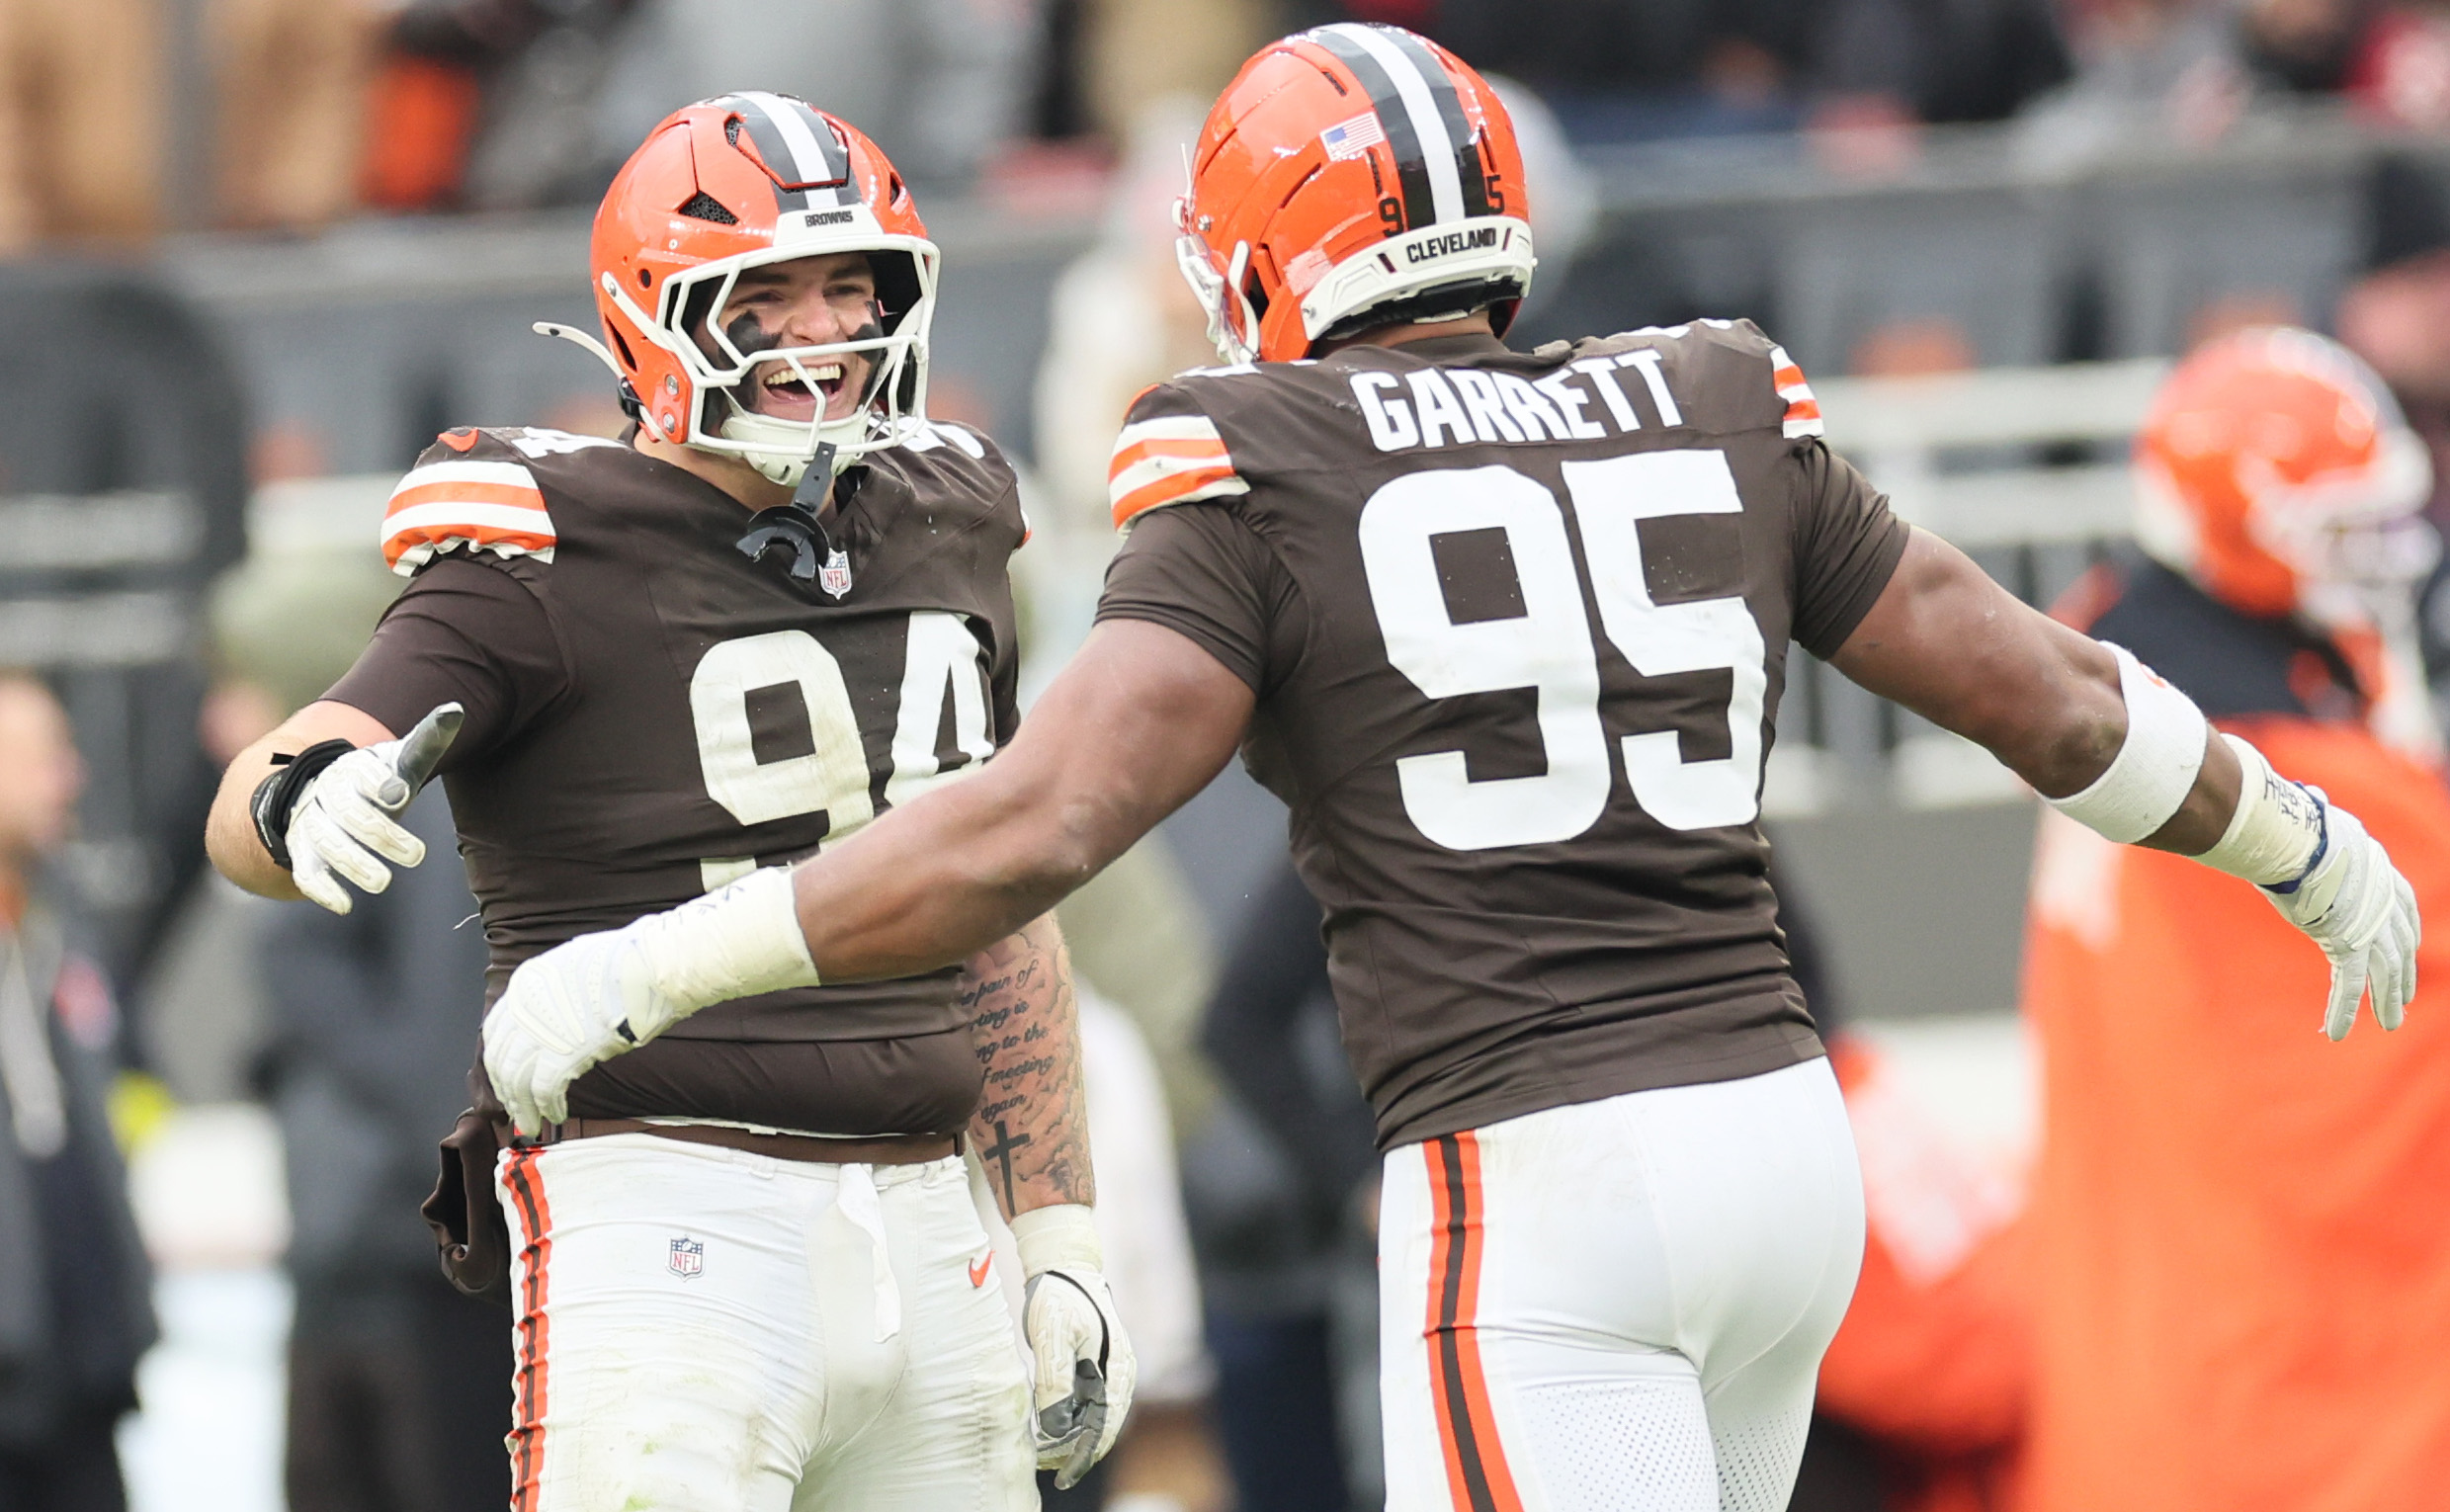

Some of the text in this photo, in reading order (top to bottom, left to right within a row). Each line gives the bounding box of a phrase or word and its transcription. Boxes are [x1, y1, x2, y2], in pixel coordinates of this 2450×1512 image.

[804, 210, 854, 227] BROWNS
[1379, 174, 1505, 238] 9 5
[1406, 227, 1496, 264] CLEVELAND
[1349, 349, 1683, 453] GARRETT
[825, 569, 848, 589] NFL
[1358, 449, 1767, 851] 95
[689, 610, 995, 891] 94
[672, 1251, 700, 1273] NFL
